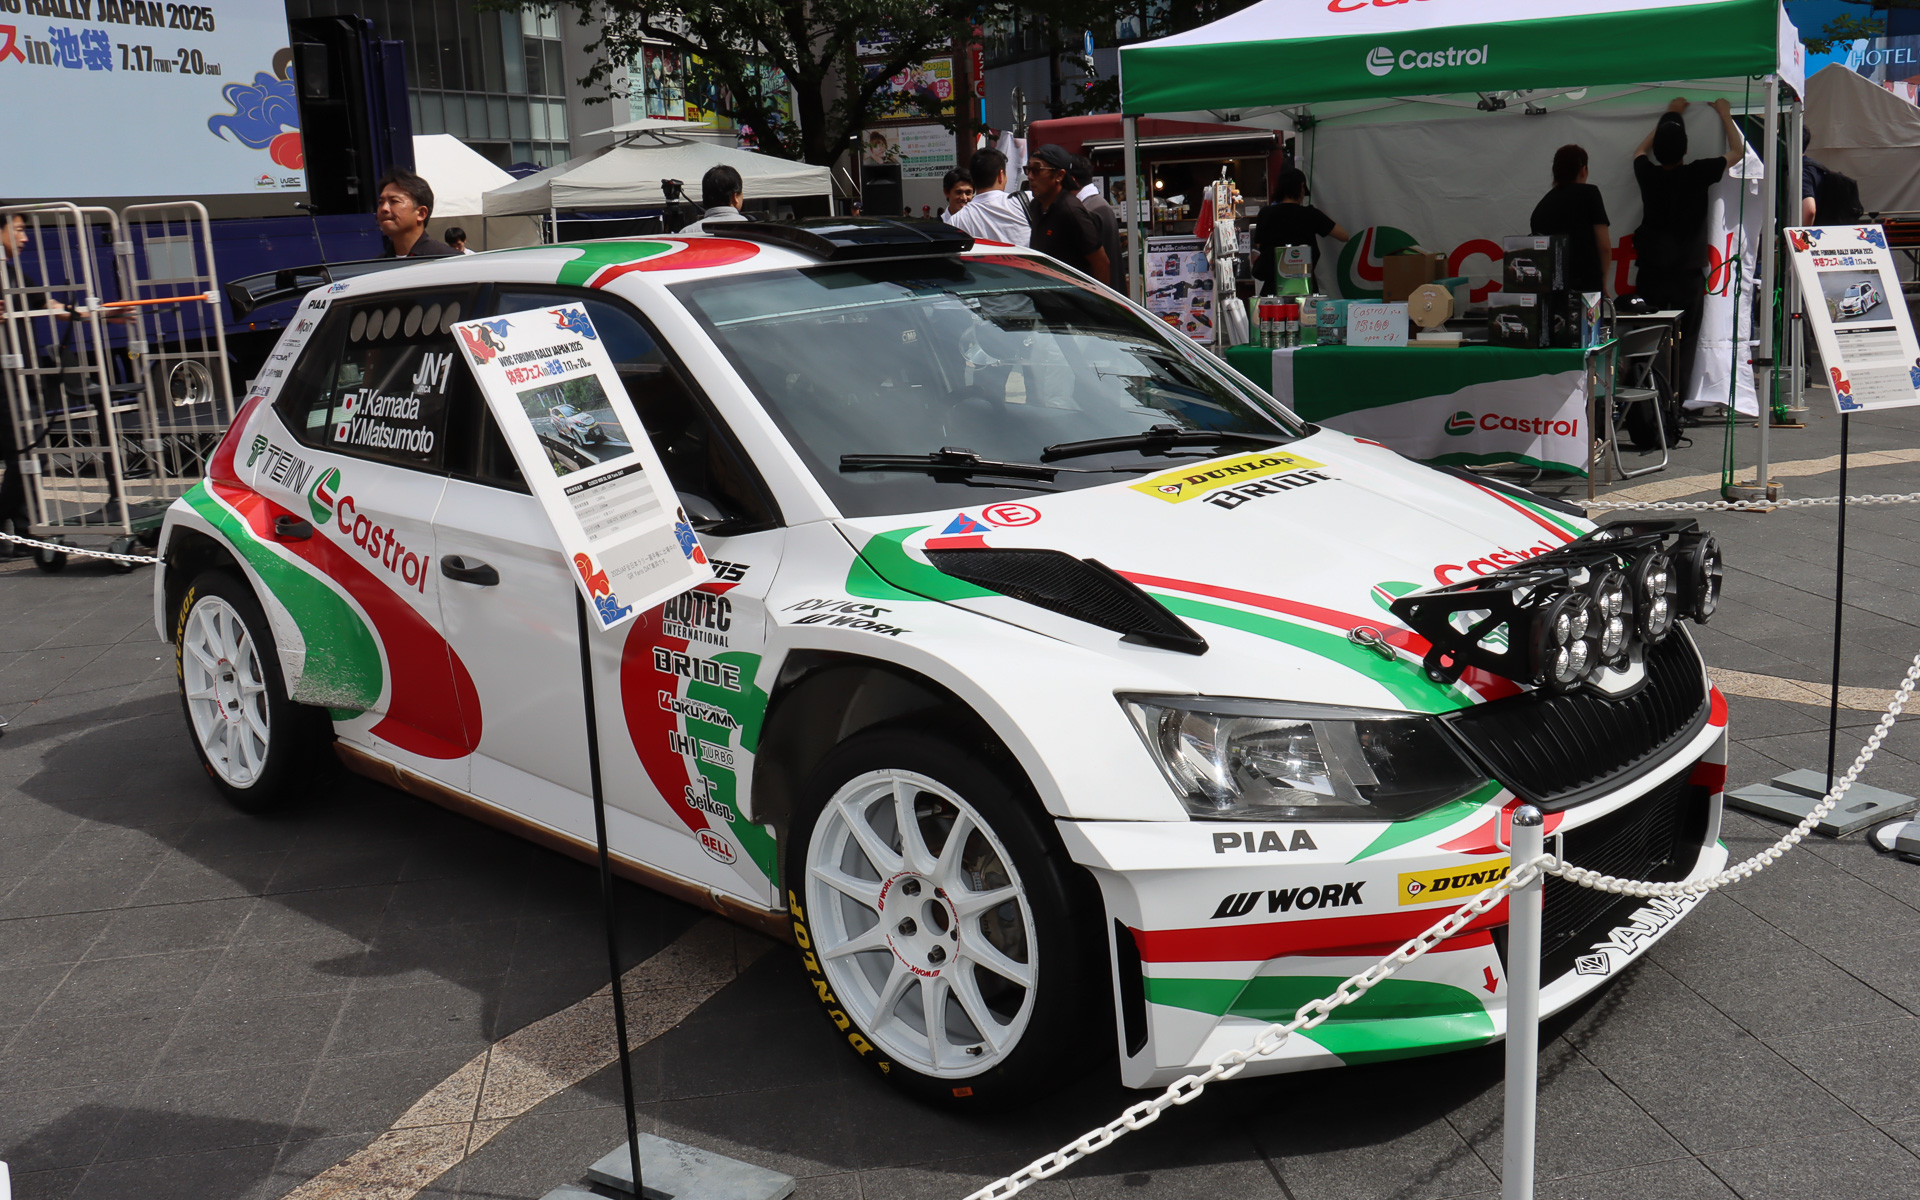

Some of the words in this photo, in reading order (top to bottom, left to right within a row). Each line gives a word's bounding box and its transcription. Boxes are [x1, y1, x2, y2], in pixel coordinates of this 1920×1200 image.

[97, 0, 165, 28] JAPAN
[166, 3, 215, 32] 2025
[1399, 44, 1488, 70] Castrol
[1852, 48, 1916, 66] HOTEL
[308, 300, 327, 310] PIAA
[1354, 306, 1388, 318] Castrol
[1354, 320, 1390, 332] 15:00
[498, 354, 514, 367] WRC
[512, 350, 537, 364] FORUM8
[534, 347, 553, 360] RALLY
[551, 342, 571, 356] JAPAN
[568, 340, 584, 352] 2025
[412, 352, 453, 394] JN1
[357, 388, 420, 420] T.Kamada
[350, 416, 434, 453] Y.Matsumoto
[1480, 413, 1578, 437] Castrol
[262, 444, 314, 494] TEIN
[1182, 456, 1295, 486] DUNLOP
[337, 496, 430, 594] Castrol
[664, 590, 732, 632] AQTEC
[176, 586, 196, 680] DUNLOP
[663, 622, 729, 648] INTERNATIONAL
[653, 646, 740, 691] BRIDE
[670, 730, 697, 758] IHI
[701, 744, 734, 766] TURBO
[686, 777, 735, 822] Seiken
[700, 832, 732, 858] BELL
[1212, 829, 1318, 854] PIAA
[1428, 866, 1511, 893] DUNLO
[1267, 881, 1367, 914] WORK
[788, 890, 874, 1056] DUNLOP
